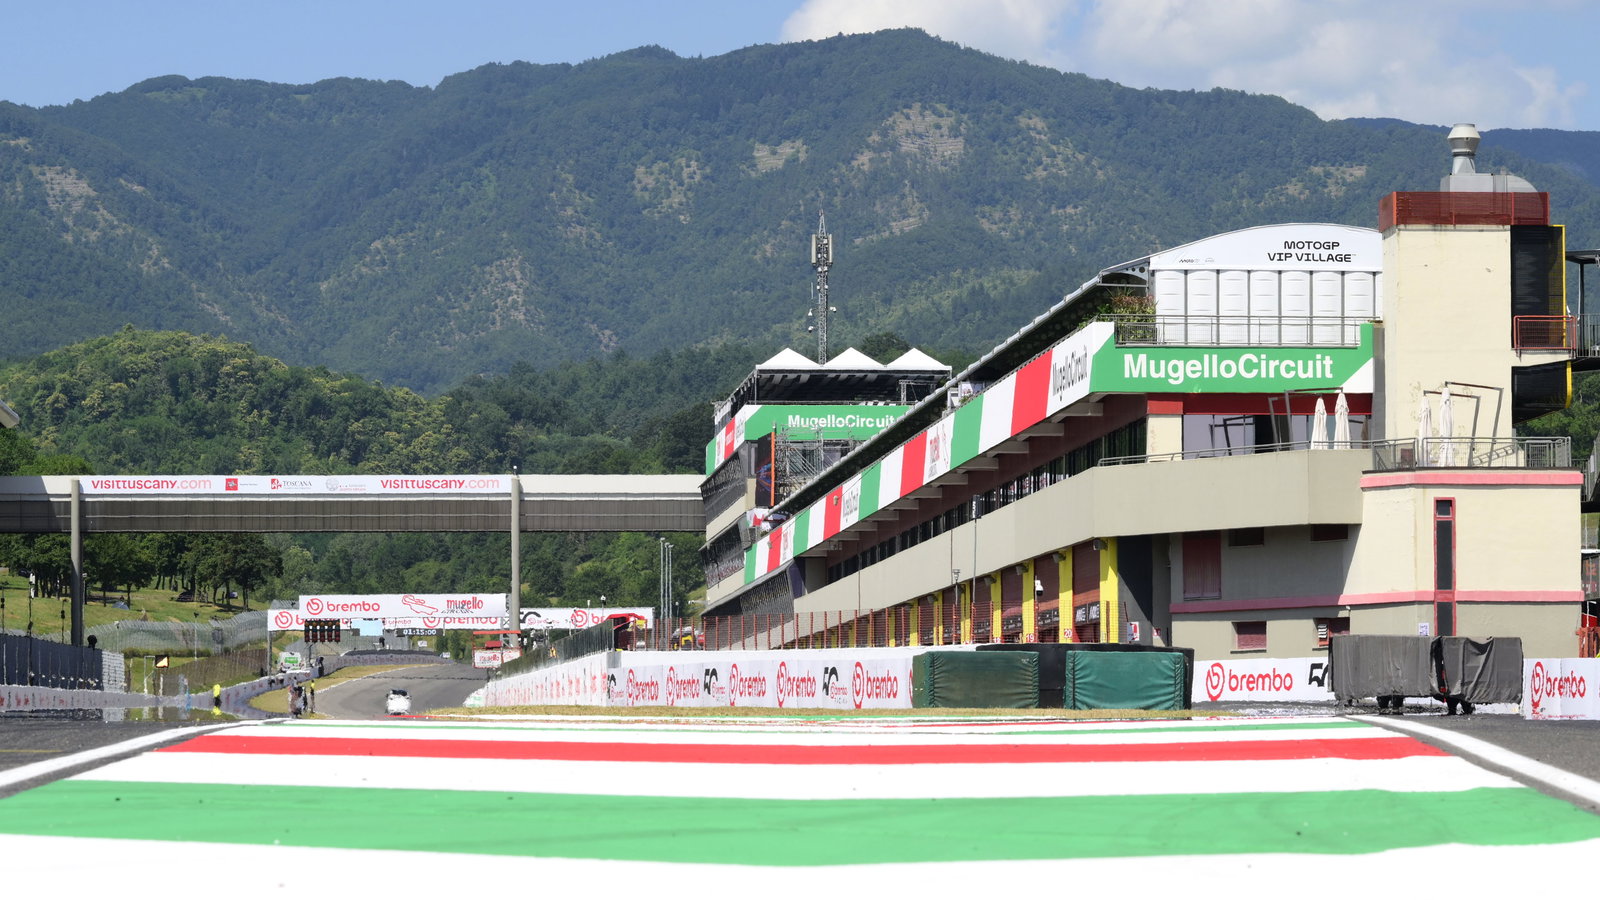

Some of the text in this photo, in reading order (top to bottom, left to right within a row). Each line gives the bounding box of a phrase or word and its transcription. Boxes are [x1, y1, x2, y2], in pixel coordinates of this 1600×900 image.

[1284, 241, 1340, 250] MOTOGP
[1268, 253, 1352, 263] VIP VILLAGE
[1123, 353, 1334, 386] MugelloCircuit
[788, 415, 896, 430] MugelloCircuit
[326, 601, 381, 612] brembo
[446, 596, 484, 610] mugello
[403, 628, 437, 636] 01:15:00
[740, 671, 766, 698] brembo
[786, 670, 816, 698] brembo
[867, 670, 898, 699] brembo
[1229, 668, 1293, 692] brembo
[1546, 671, 1587, 699] brembo
